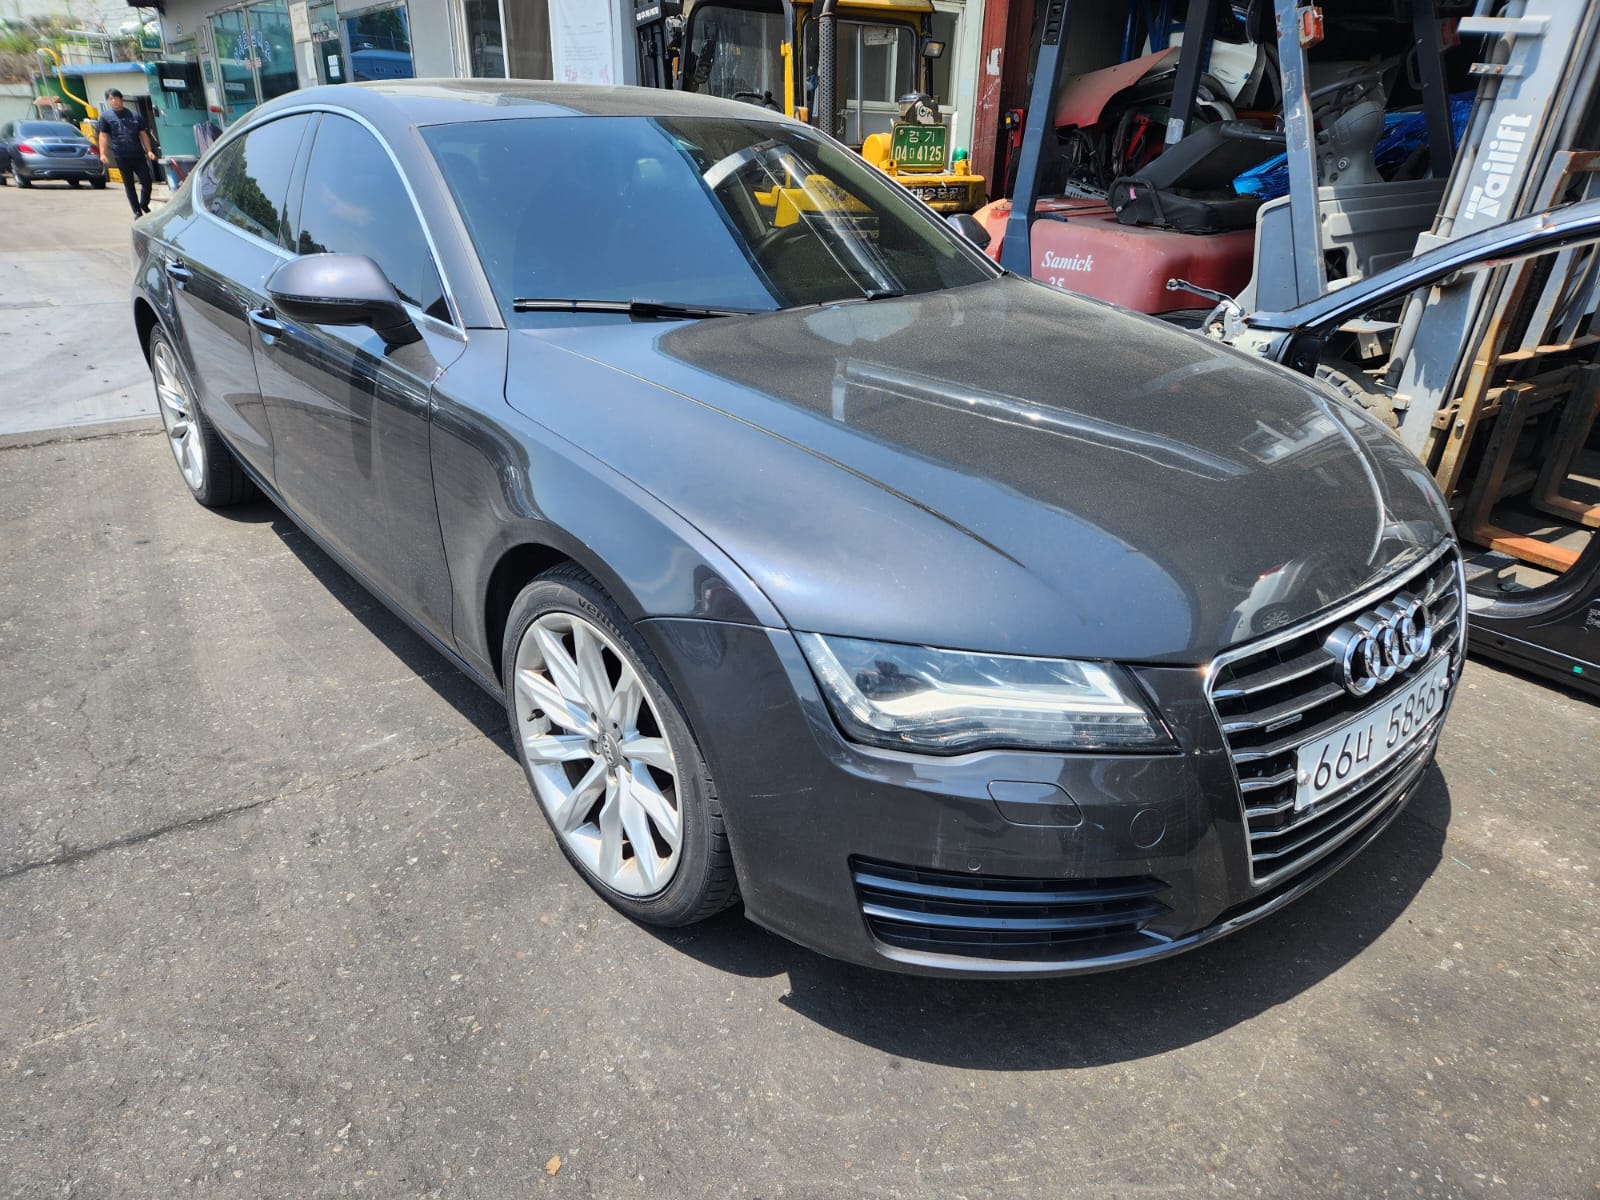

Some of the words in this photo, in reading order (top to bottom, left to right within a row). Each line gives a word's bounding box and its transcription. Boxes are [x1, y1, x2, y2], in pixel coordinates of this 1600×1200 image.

[1041, 250, 1094, 272] Samick
[1314, 723, 1374, 791] 66나
[1386, 671, 1437, 749] 5856
